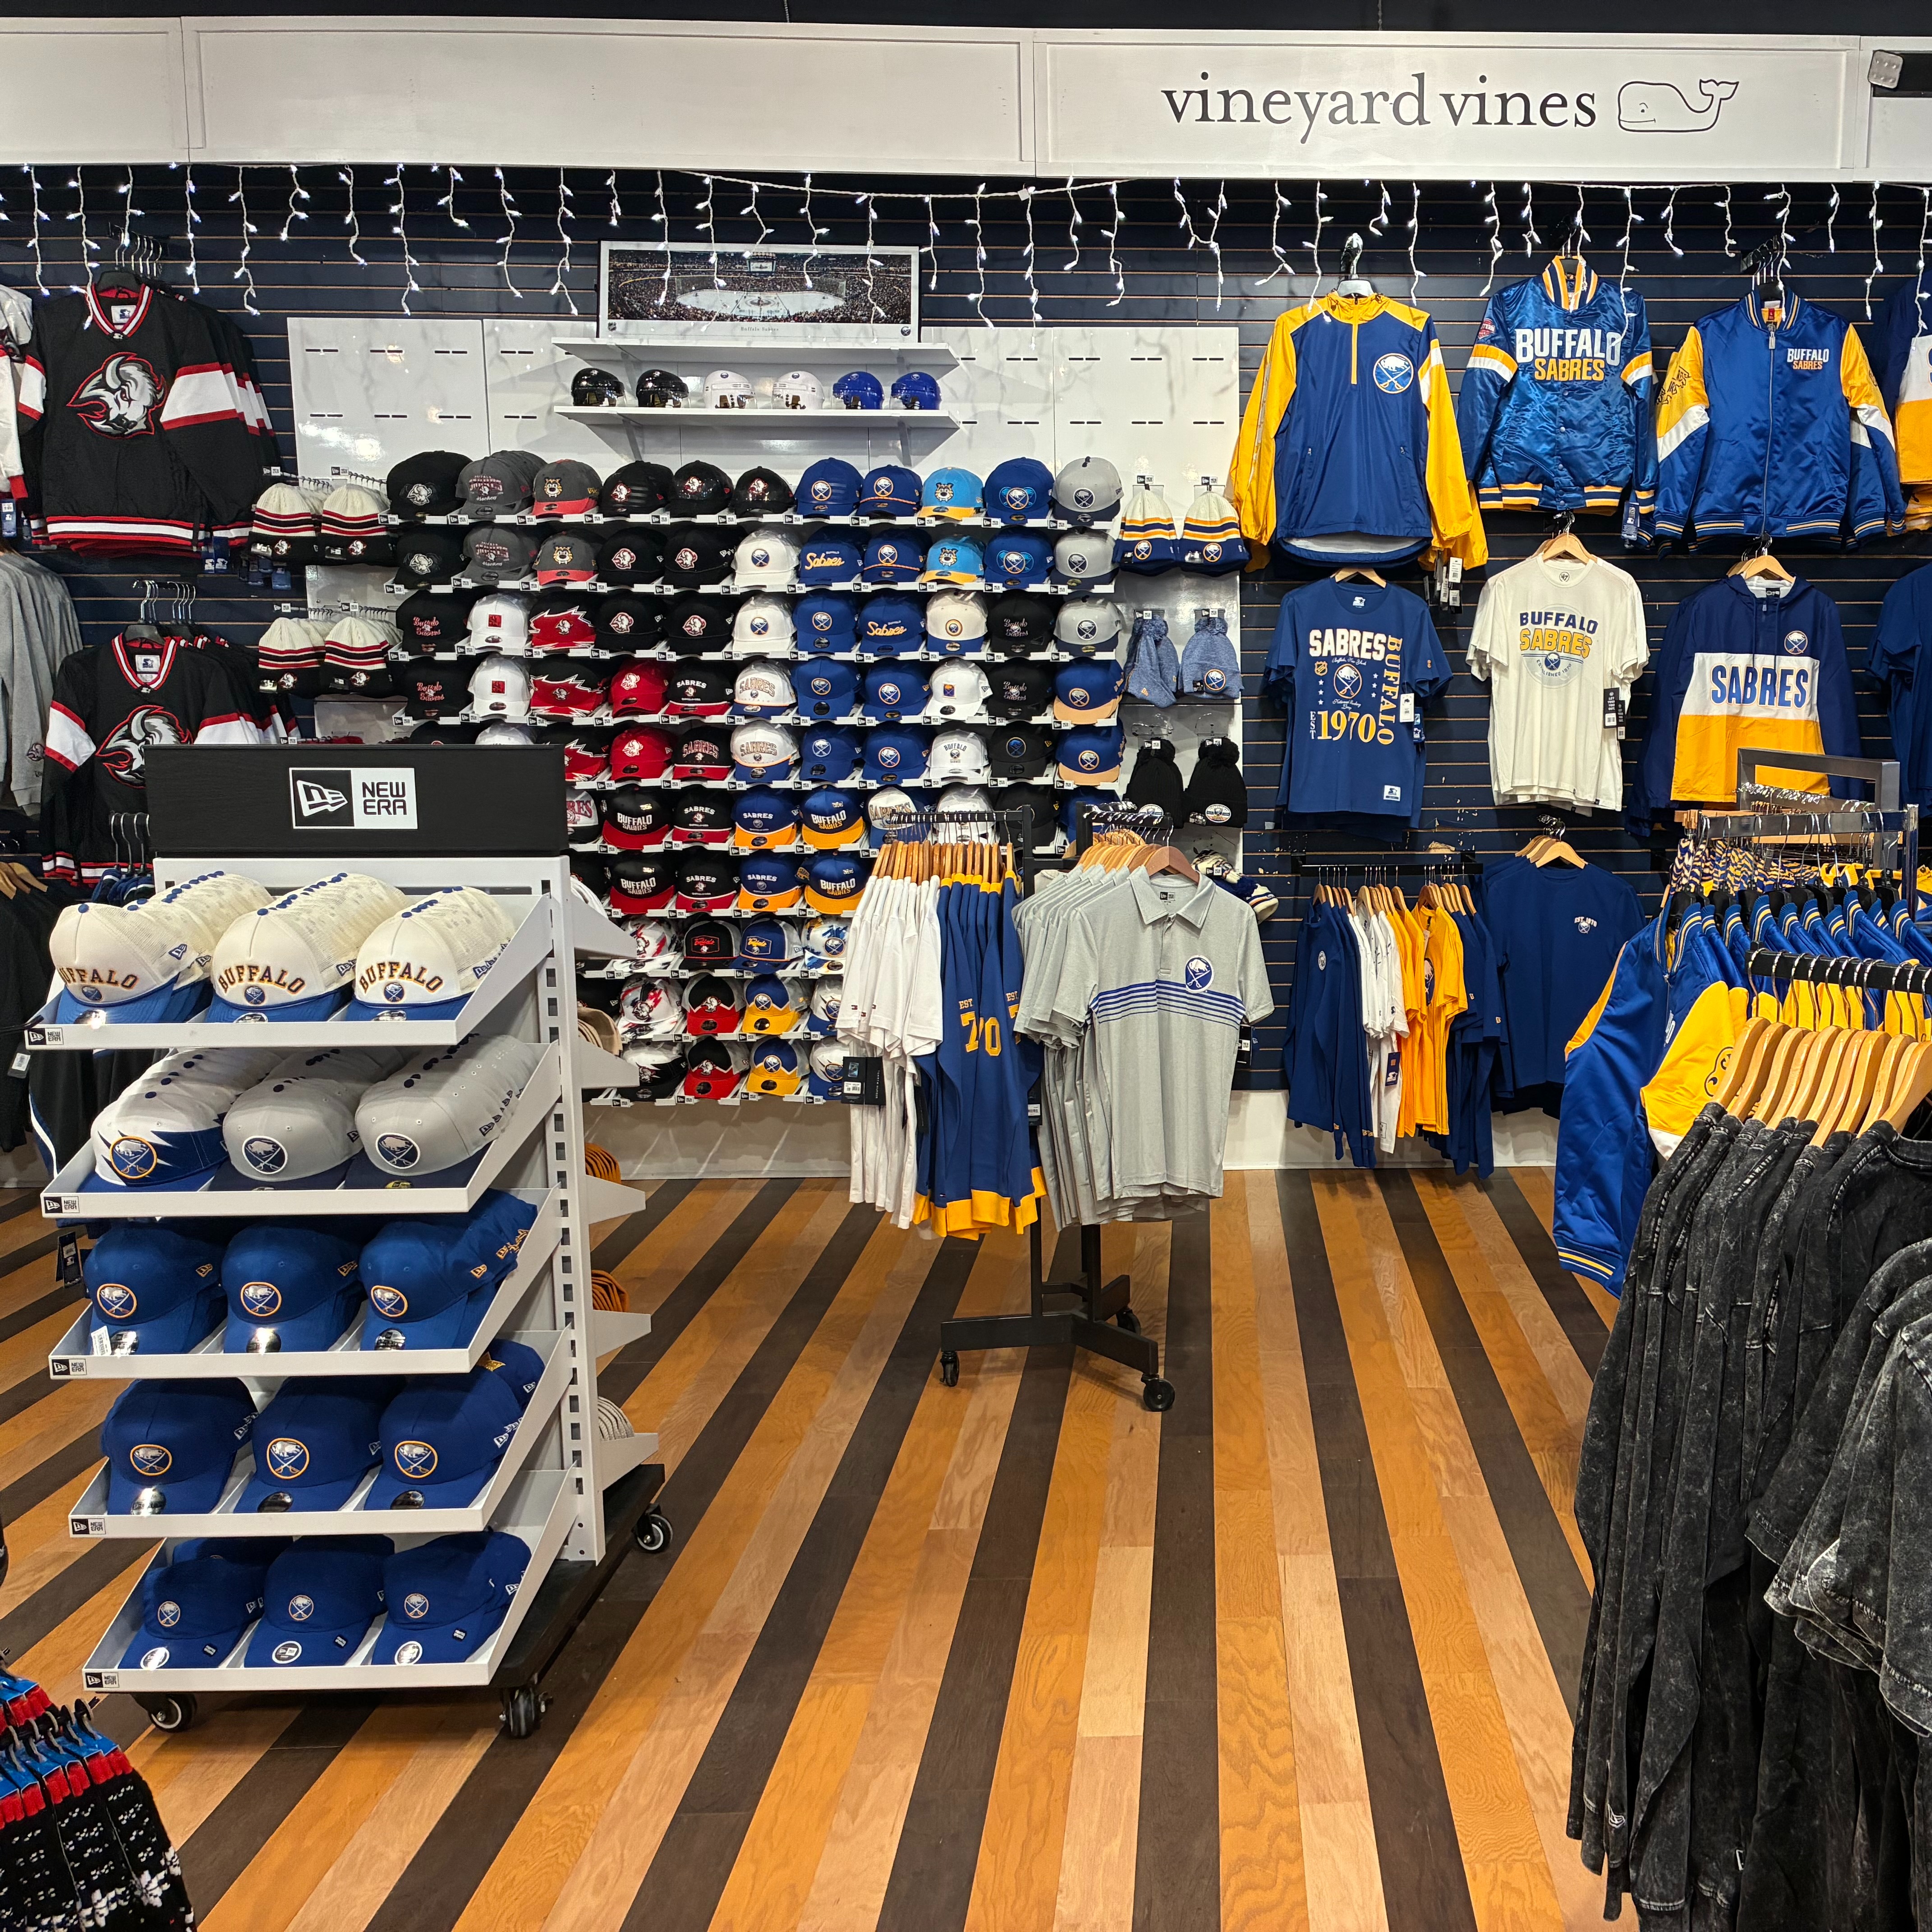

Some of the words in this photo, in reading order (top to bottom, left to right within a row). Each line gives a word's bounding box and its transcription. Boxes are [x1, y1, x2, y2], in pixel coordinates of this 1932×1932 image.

[1161, 72, 1430, 144] vineyard
[1440, 74, 1597, 128] vines
[1515, 328, 1622, 366] BUFFALO
[1787, 348, 1830, 363] BUFFALO
[1534, 358, 1605, 382] SABRES
[1793, 360, 1823, 370] SABRES
[805, 552, 845, 570] Sabres
[867, 621, 907, 636] Sabres
[1520, 611, 1598, 634] BUFFALO
[1309, 629, 1386, 661] SABRES
[1520, 628, 1592, 659] SABRES
[676, 680, 707, 688] SABRES
[739, 677, 776, 697] SABRES
[1377, 635, 1403, 745] BUFFALO
[1711, 663, 1809, 707] SABRES
[1317, 709, 1376, 743] 1970
[682, 740, 720, 759] SABRES
[740, 741, 778, 757] SABRES
[943, 743, 967, 752] BUFFALO
[363, 782, 406, 798] NEW
[363, 799, 407, 815] ERA
[684, 806, 716, 815] SABRES
[617, 812, 652, 825] BUFFALO
[811, 810, 846, 824] BUFFALO
[621, 877, 657, 889] BUFFALO
[820, 878, 856, 889] BUFFALO
[217, 965, 306, 994] BUFFALO
[359, 961, 444, 994] BUFFALO
[960, 1011, 1001, 1057] 70
